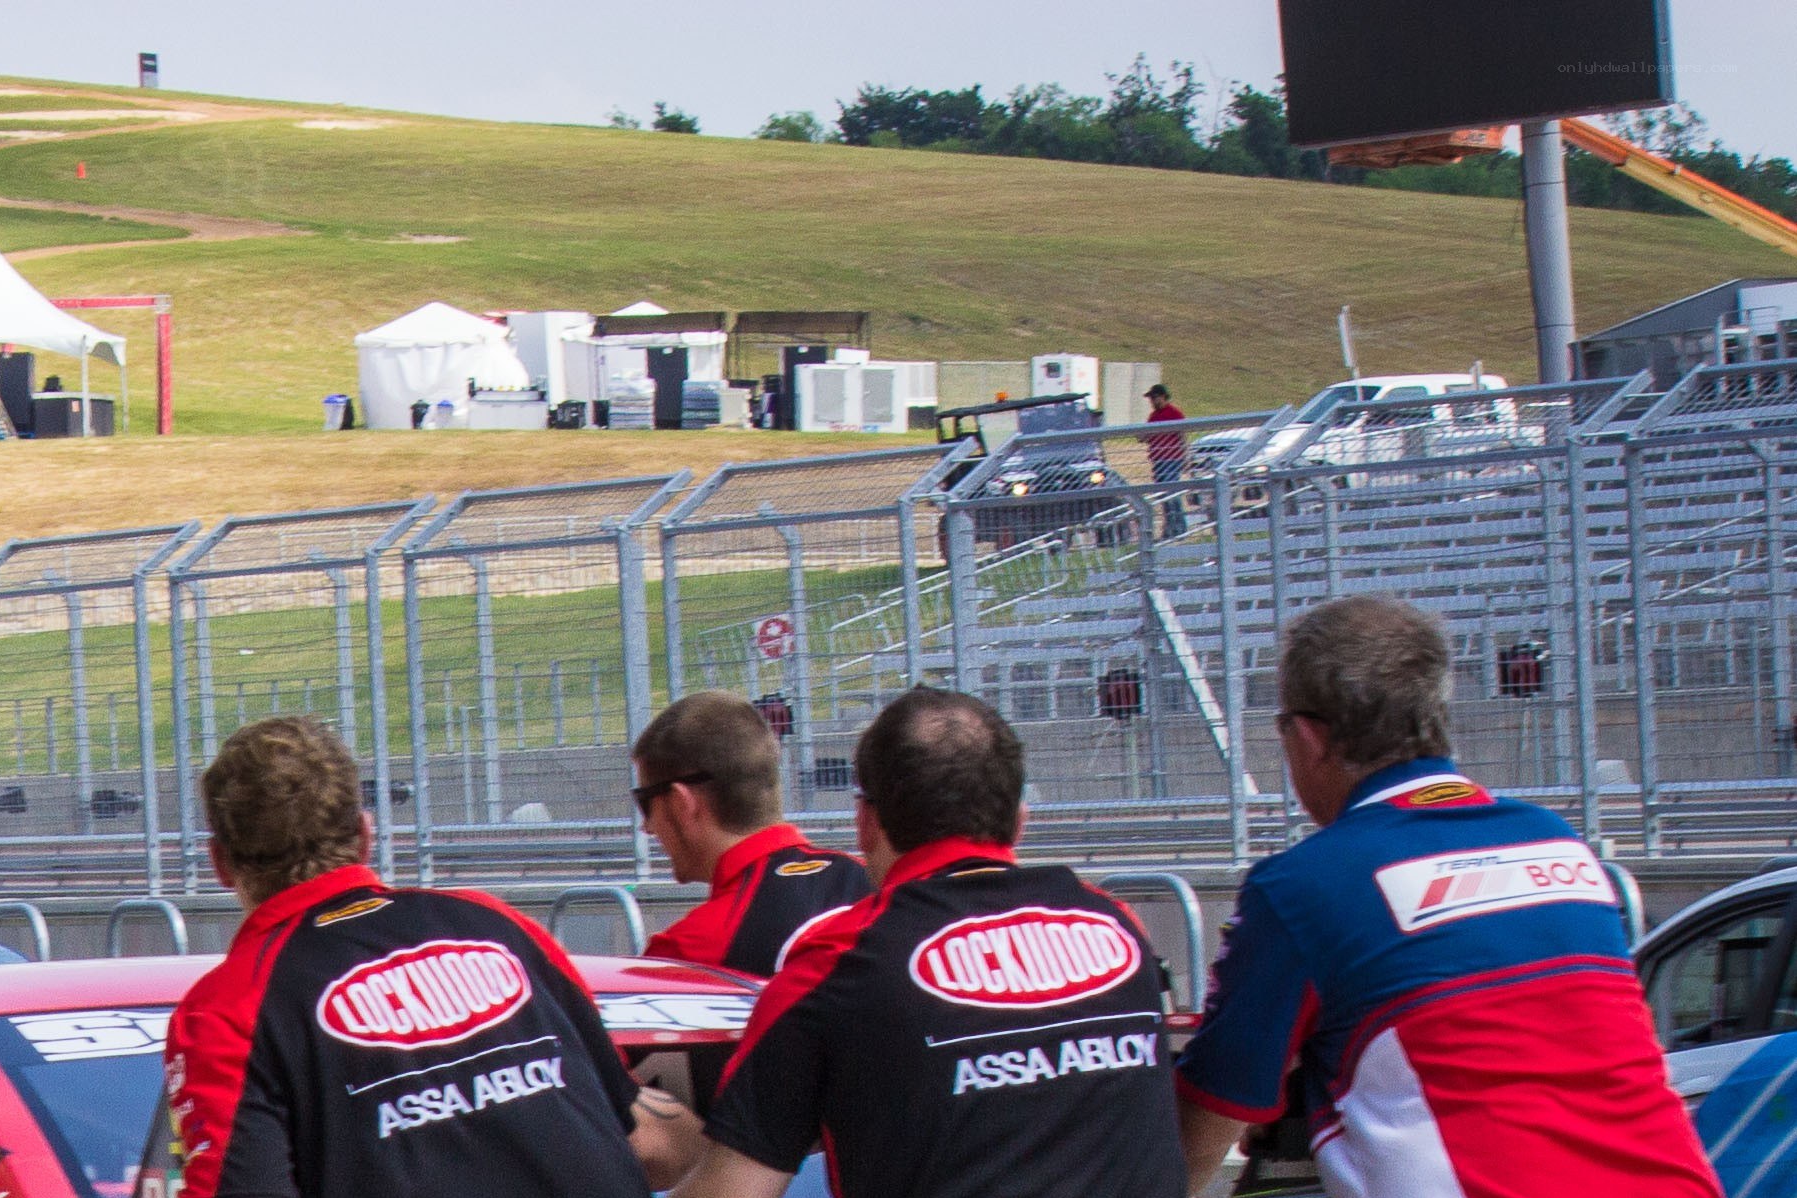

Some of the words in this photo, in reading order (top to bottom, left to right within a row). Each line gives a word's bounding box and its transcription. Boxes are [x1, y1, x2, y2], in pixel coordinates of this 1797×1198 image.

[1525, 862, 1599, 887] BOC
[332, 951, 519, 1034] LOCKWOOD
[928, 921, 1126, 993] LOCKWOOD
[378, 1080, 475, 1138] ASSA
[473, 1057, 566, 1112] ABLOY
[953, 1051, 1057, 1095] ASSA
[1057, 1033, 1159, 1079] ABLOY
